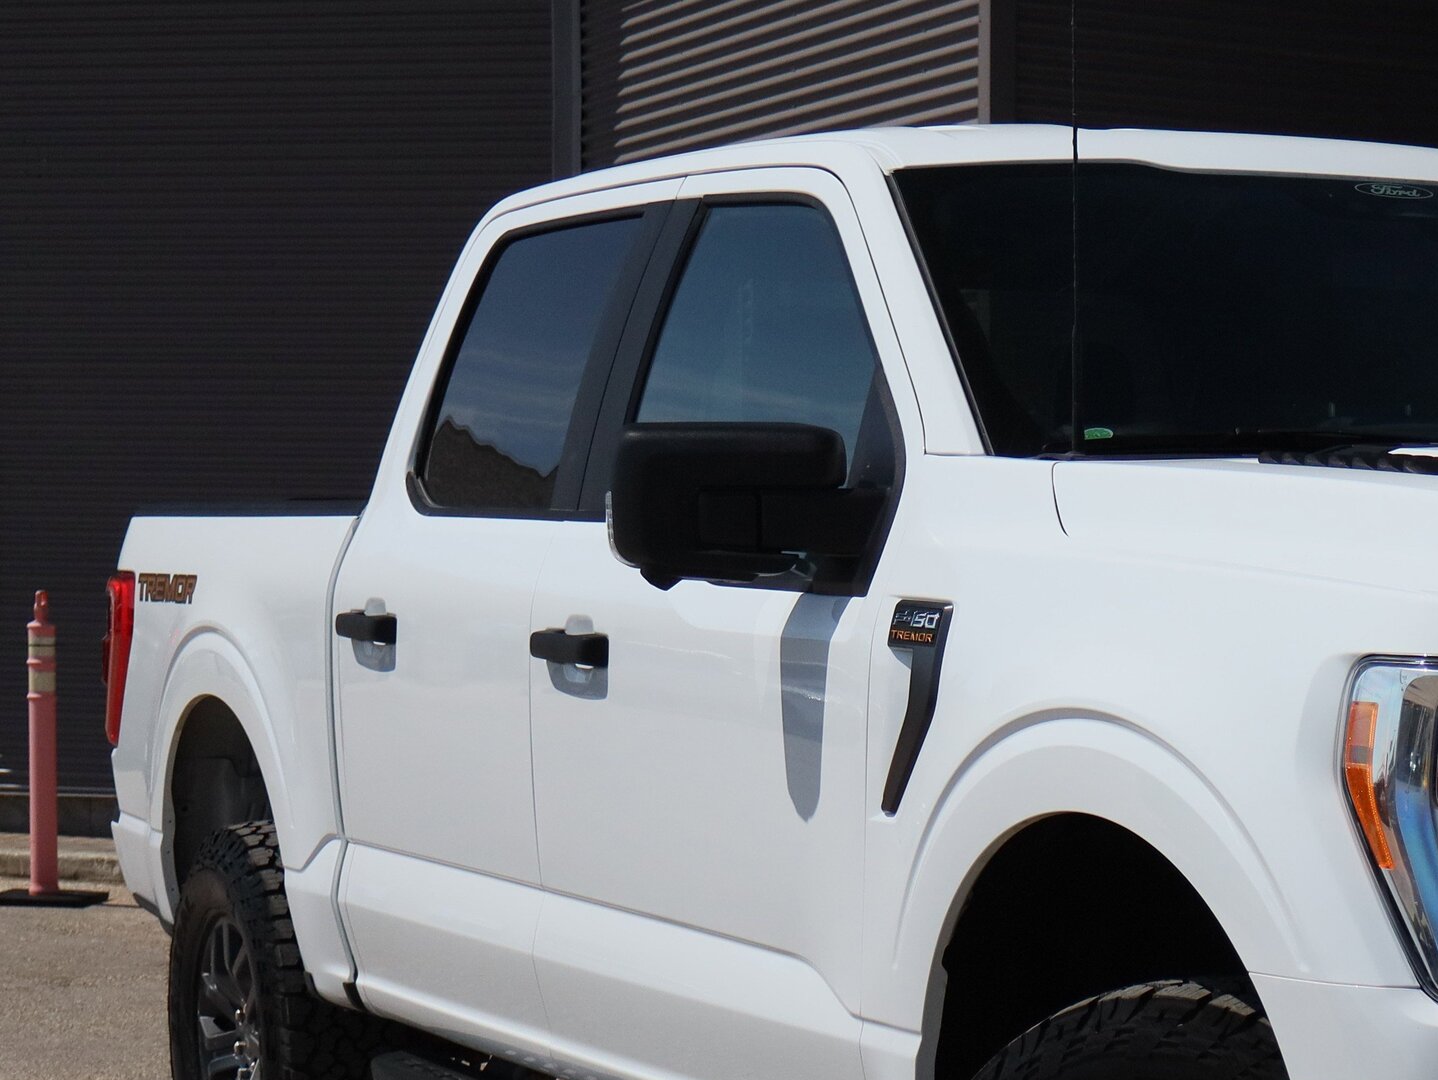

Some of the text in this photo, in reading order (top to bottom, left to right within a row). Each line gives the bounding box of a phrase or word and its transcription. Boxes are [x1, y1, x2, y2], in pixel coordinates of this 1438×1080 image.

[1370, 183, 1421, 198] Ford
[138, 572, 198, 604] TREMOR
[892, 610, 940, 629] F-150
[890, 629, 933, 643] TREMOR
